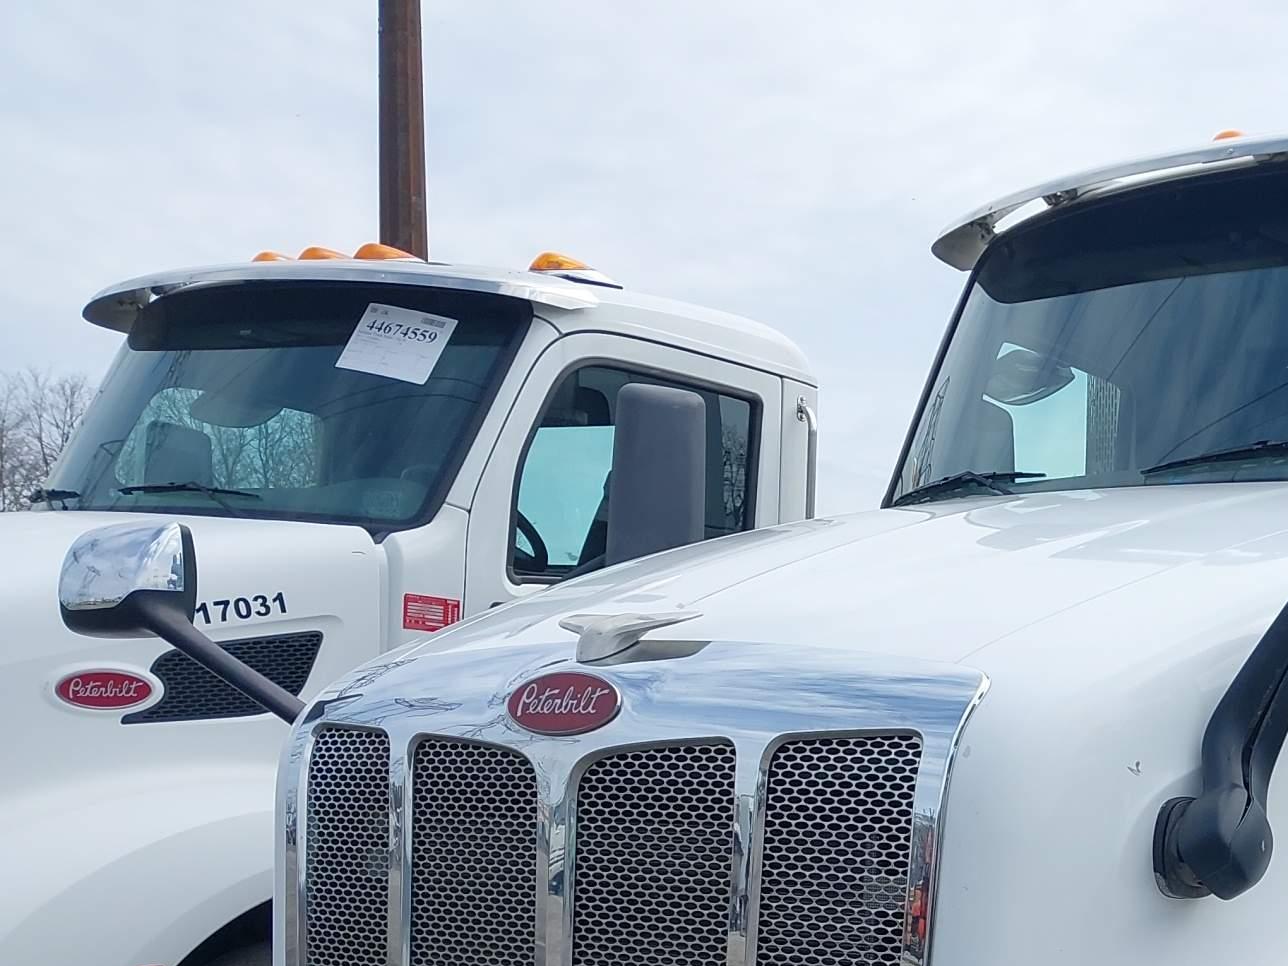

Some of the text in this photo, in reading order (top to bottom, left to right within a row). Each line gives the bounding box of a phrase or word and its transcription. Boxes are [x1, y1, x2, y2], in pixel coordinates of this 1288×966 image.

[366, 319, 438, 344] 44674559
[195, 591, 287, 625] 17031
[68, 678, 144, 699] Peterbilt
[516, 683, 610, 717] Peterbilt
